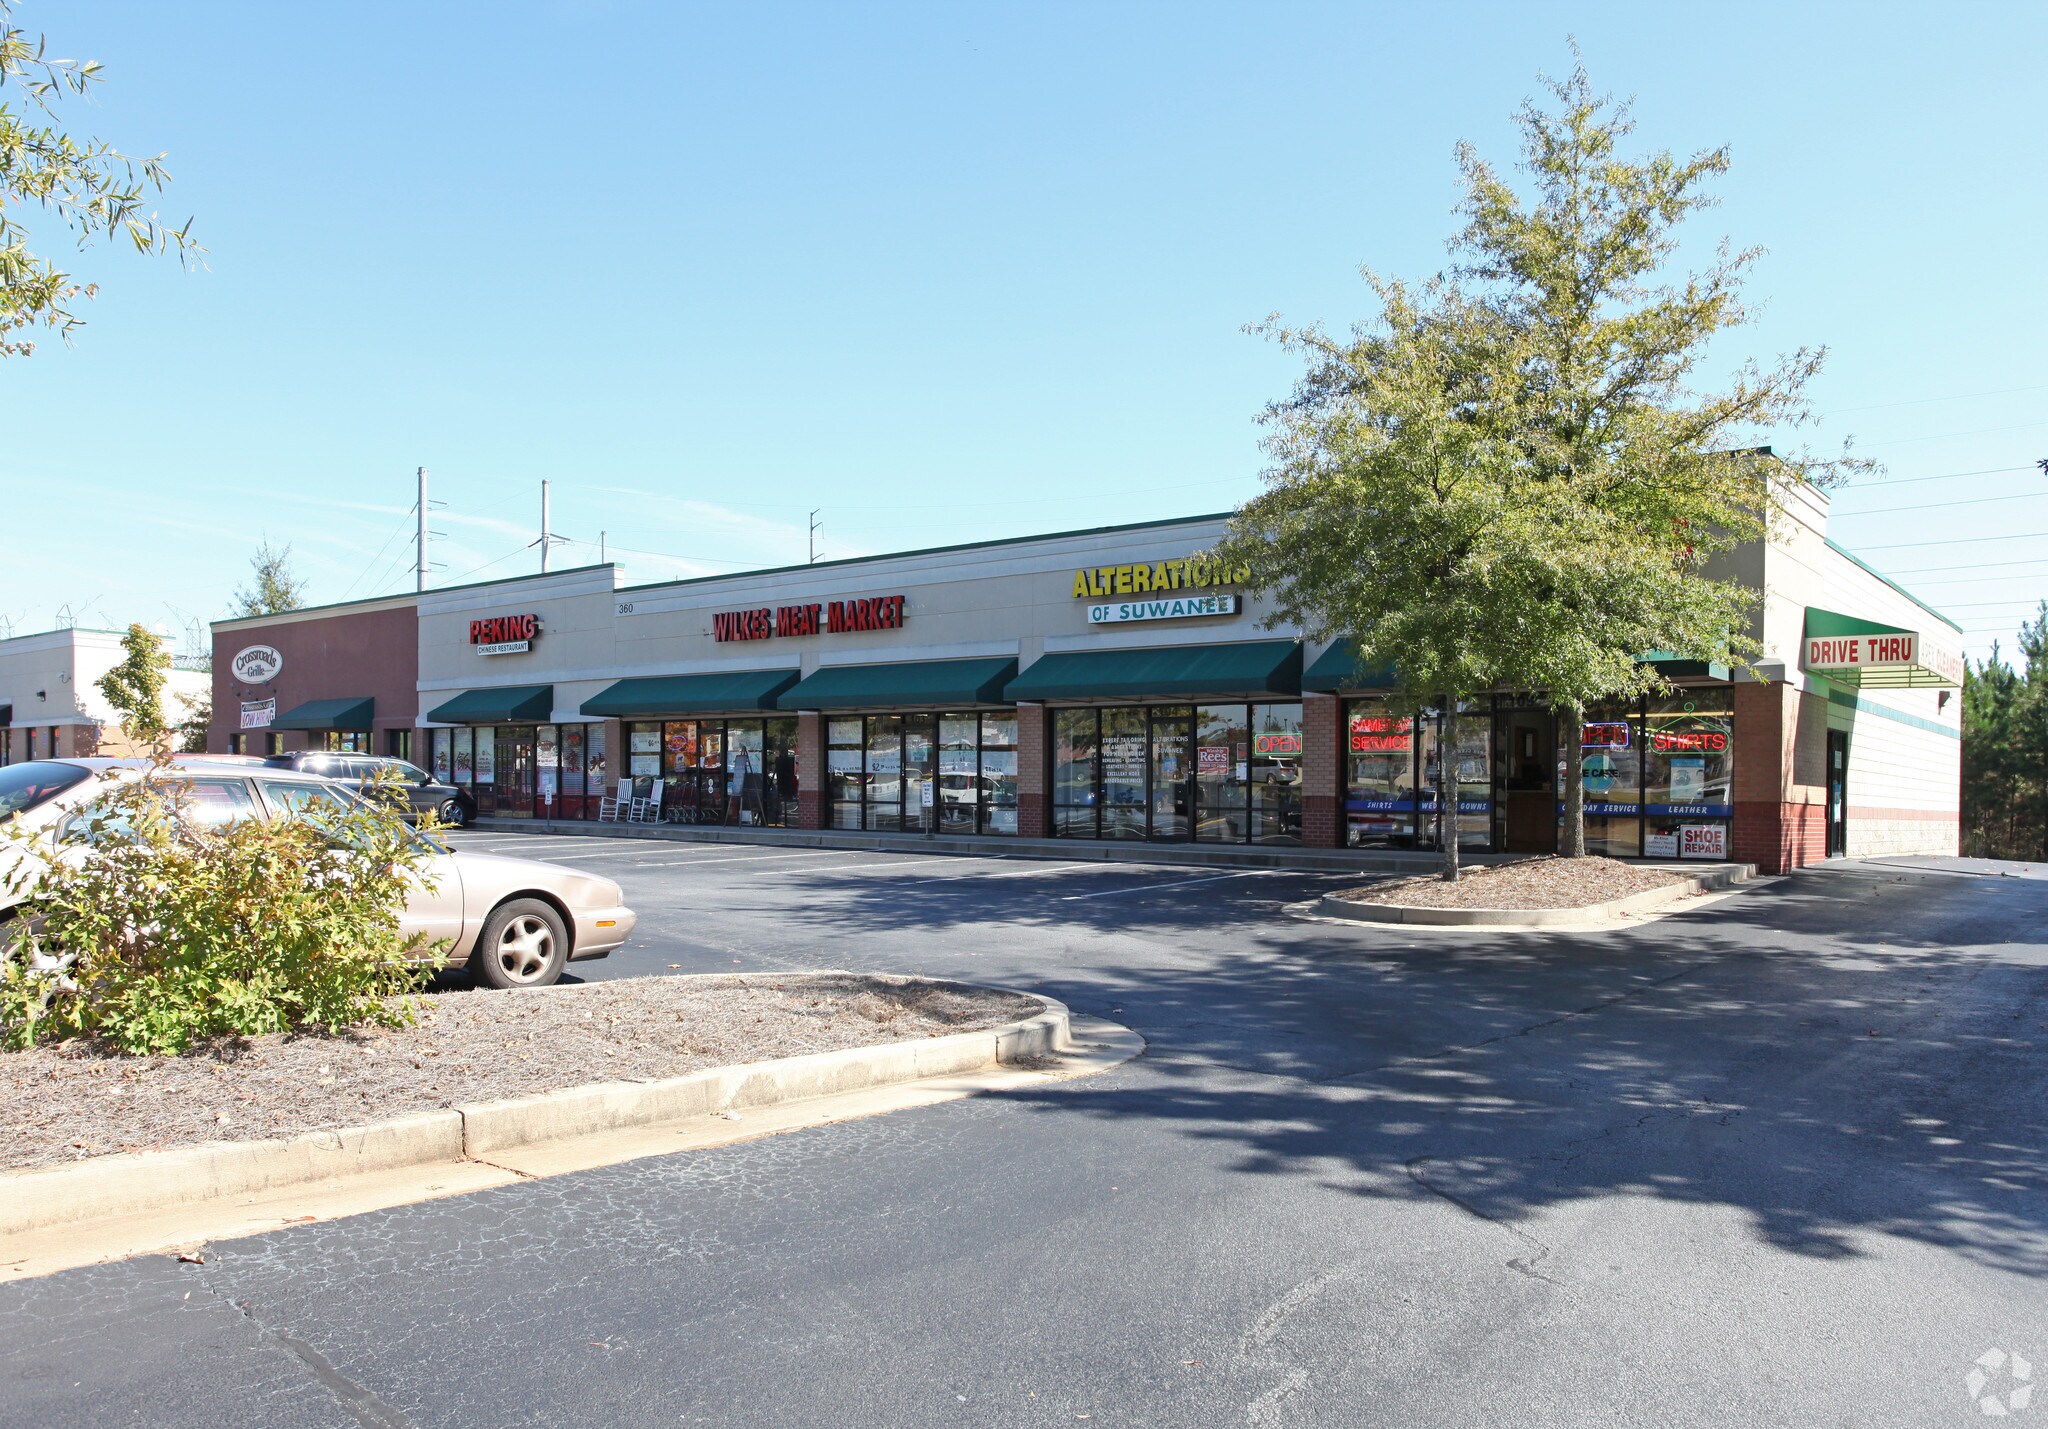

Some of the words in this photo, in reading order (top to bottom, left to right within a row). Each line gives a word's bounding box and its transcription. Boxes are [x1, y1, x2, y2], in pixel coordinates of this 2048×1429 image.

[618, 603, 634, 614] 360
[1092, 606, 1110, 622] OF
[1119, 596, 1228, 620] SUWANEE
[712, 607, 771, 642] WILKES
[775, 603, 822, 637] MEAT
[826, 595, 905, 633] MARKET
[469, 613, 537, 644] PEKING
[478, 645, 498, 654] CHINESE
[498, 642, 528, 653] RESTAURANT
[1810, 640, 1859, 664] DRIVE
[1867, 637, 1912, 662] THRU
[236, 650, 277, 671] Crossroads
[247, 664, 265, 678] Grille
[1257, 735, 1301, 753] OPEN
[1351, 735, 1412, 750] SERVICE
[1654, 733, 1725, 750] SHIRTS
[1199, 751, 1227, 762] Rees
[1367, 801, 1393, 809] SHIRTS
[1460, 802, 1487, 811] GOWNS
[1603, 804, 1637, 813] SERVICE
[1668, 805, 1708, 814] LEATHER
[1685, 829, 1722, 844] SHOE
[1684, 843, 1722, 854] REPAIR
